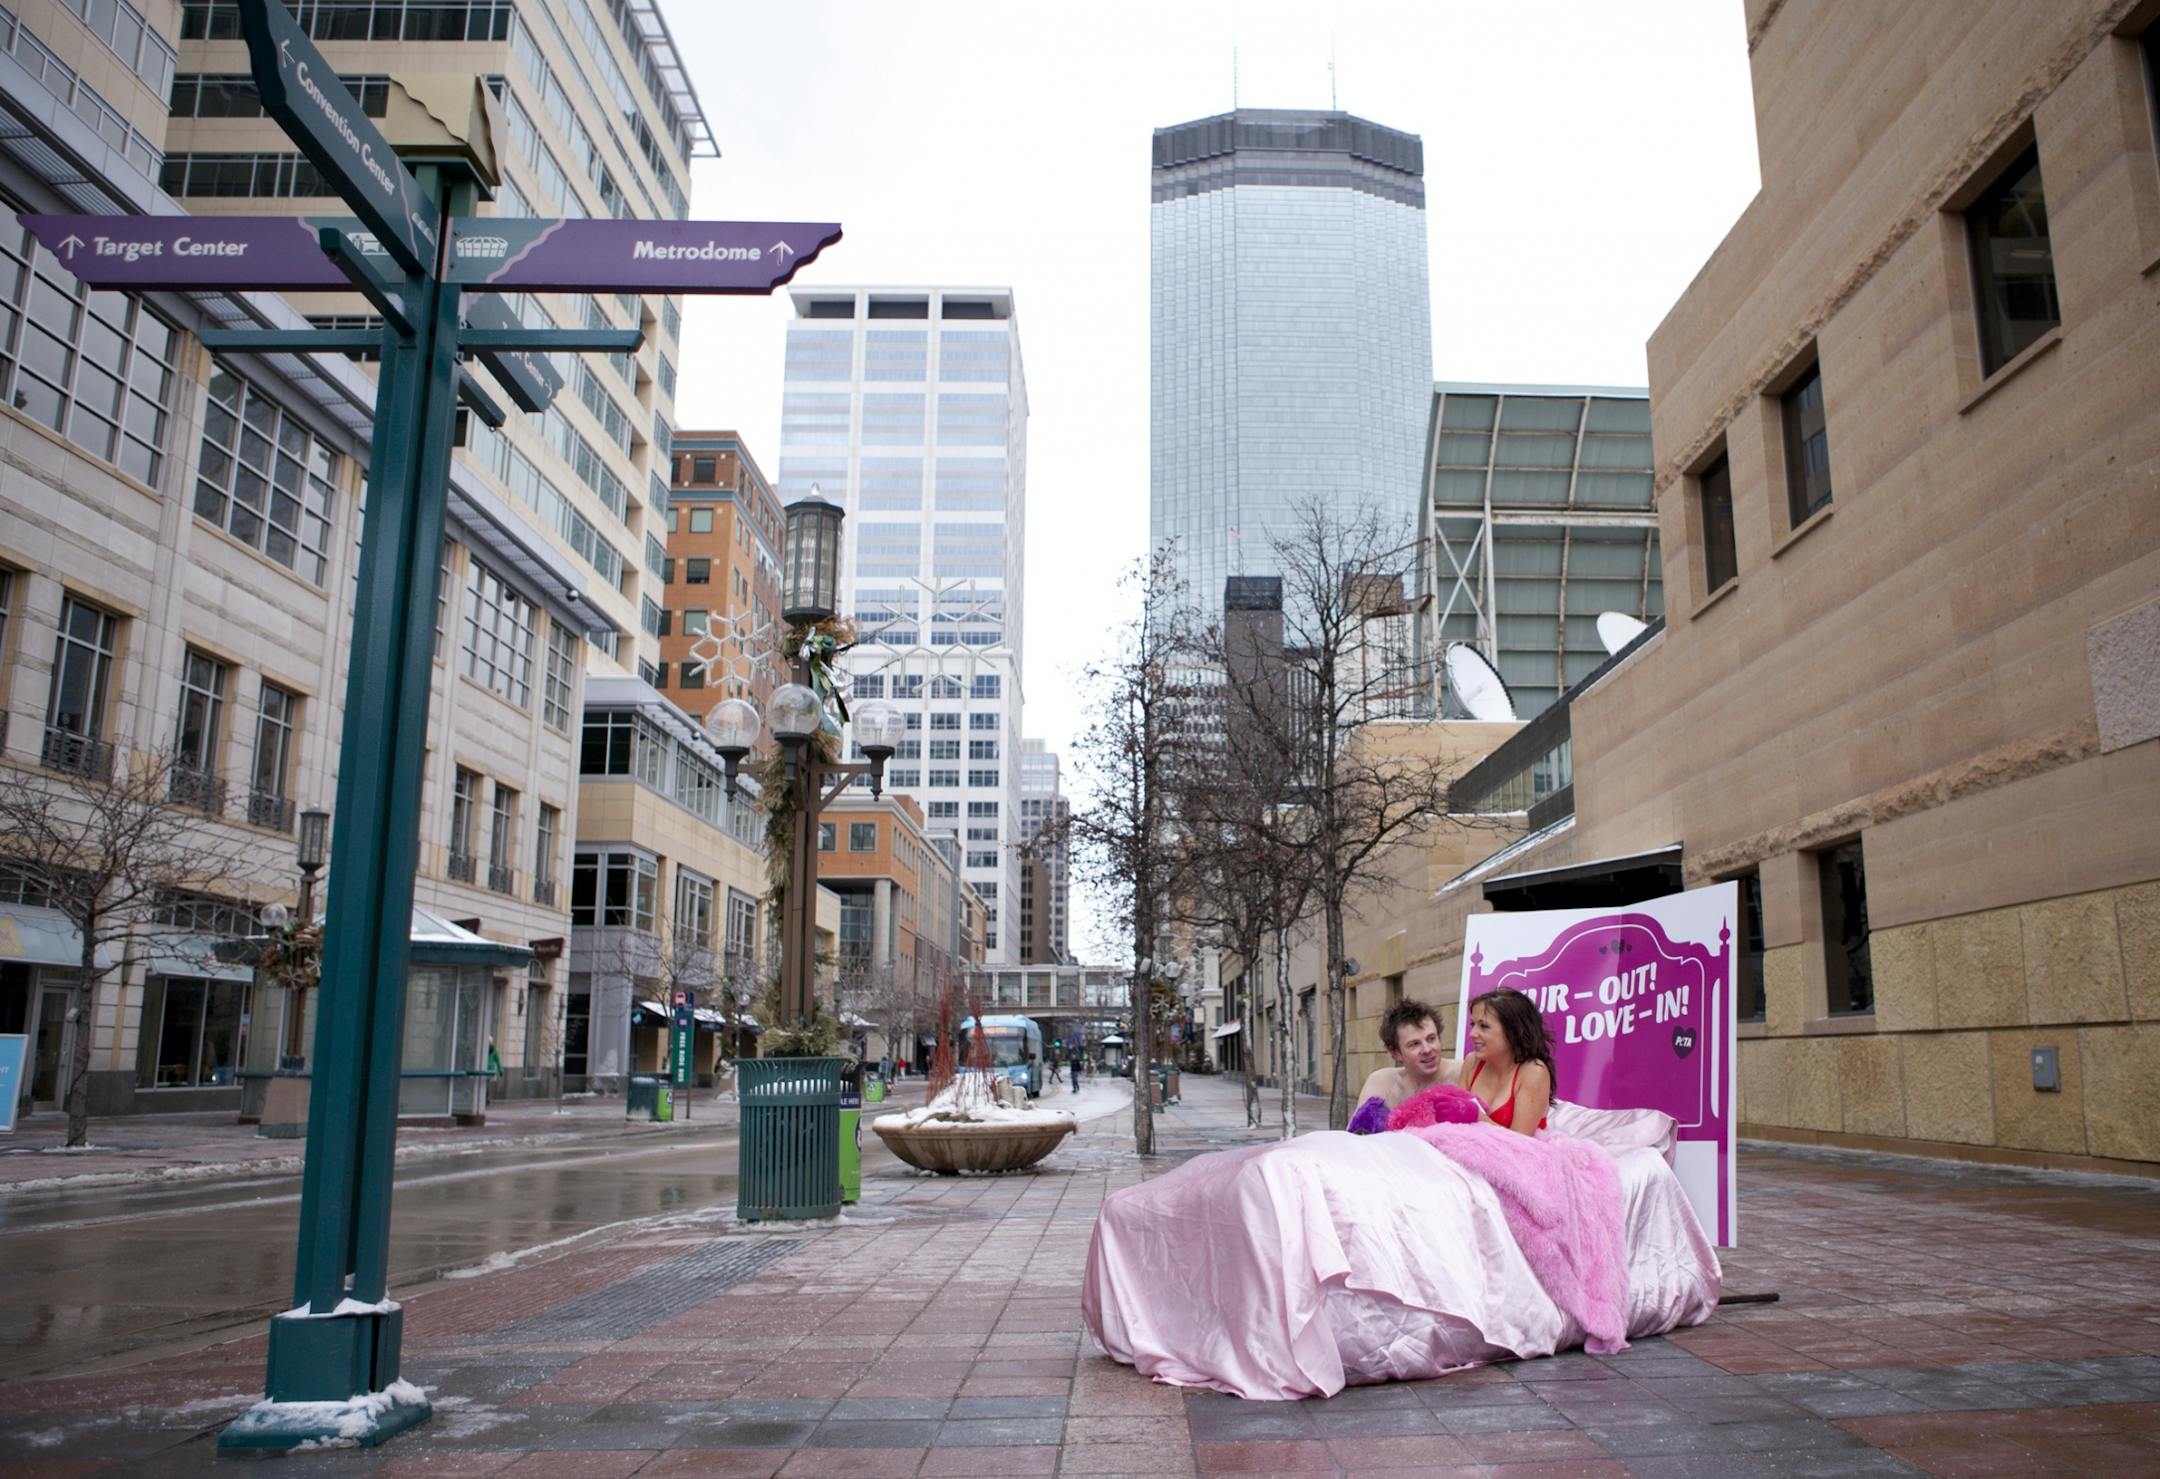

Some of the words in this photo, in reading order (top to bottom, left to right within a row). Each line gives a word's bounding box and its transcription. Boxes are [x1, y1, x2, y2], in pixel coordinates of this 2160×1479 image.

[297, 61, 360, 154] Convention
[361, 143, 395, 195] Center
[93, 236, 164, 262] Target
[173, 236, 249, 256] Center
[633, 240, 762, 261] Metrodome
